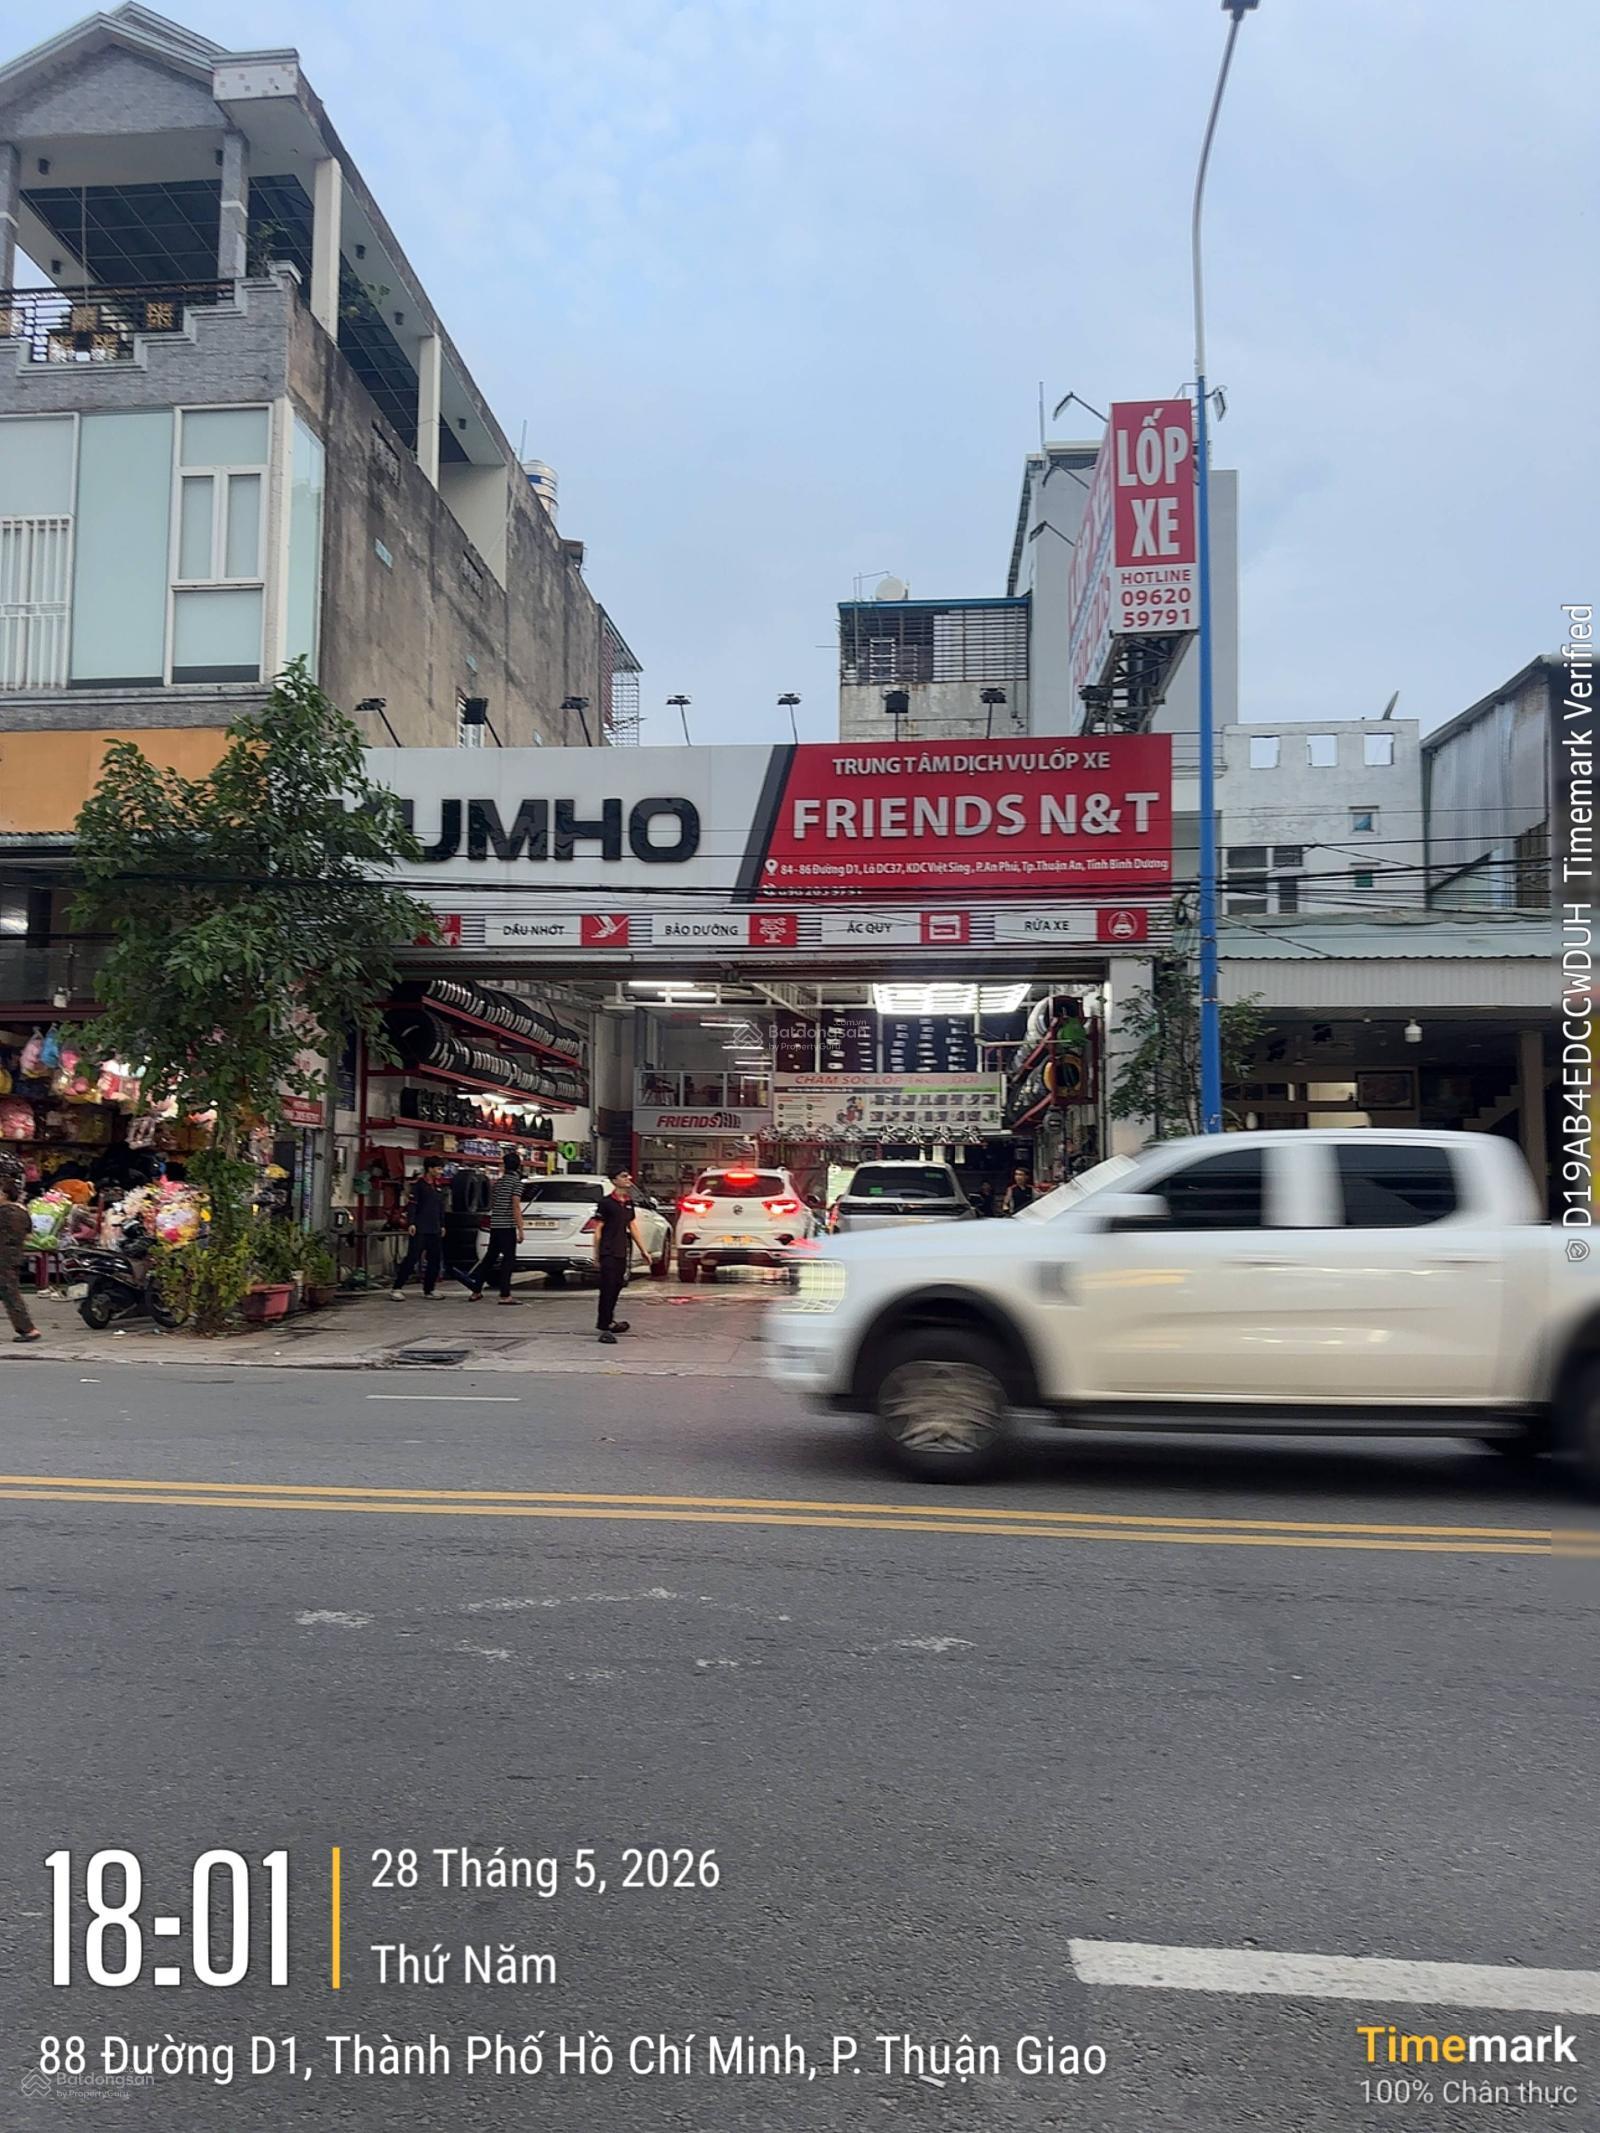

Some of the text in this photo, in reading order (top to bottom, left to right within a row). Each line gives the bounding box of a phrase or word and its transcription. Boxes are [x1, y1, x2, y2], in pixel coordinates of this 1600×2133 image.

[1116, 407, 1189, 488] LỐP
[1130, 497, 1180, 557] XE
[1120, 569, 1191, 585] HOTLINE
[1120, 586, 1192, 607] 09620
[1122, 608, 1191, 628] 59791
[832, 747, 1111, 776] TRUNG TÂM DỊCH VỤ LỐP XE
[792, 791, 1161, 840] FRIENDS N&T
[780, 864, 794, 875] 84
[799, 863, 812, 874] 86
[812, 863, 846, 877] Đường
[846, 863, 863, 875] D1,
[906, 862, 928, 873] KDC
[664, 922, 739, 936] BẢO DƯỠNG
[1024, 918, 1070, 931] RỬA XE
[656, 1115, 718, 1128] FRIENDS
